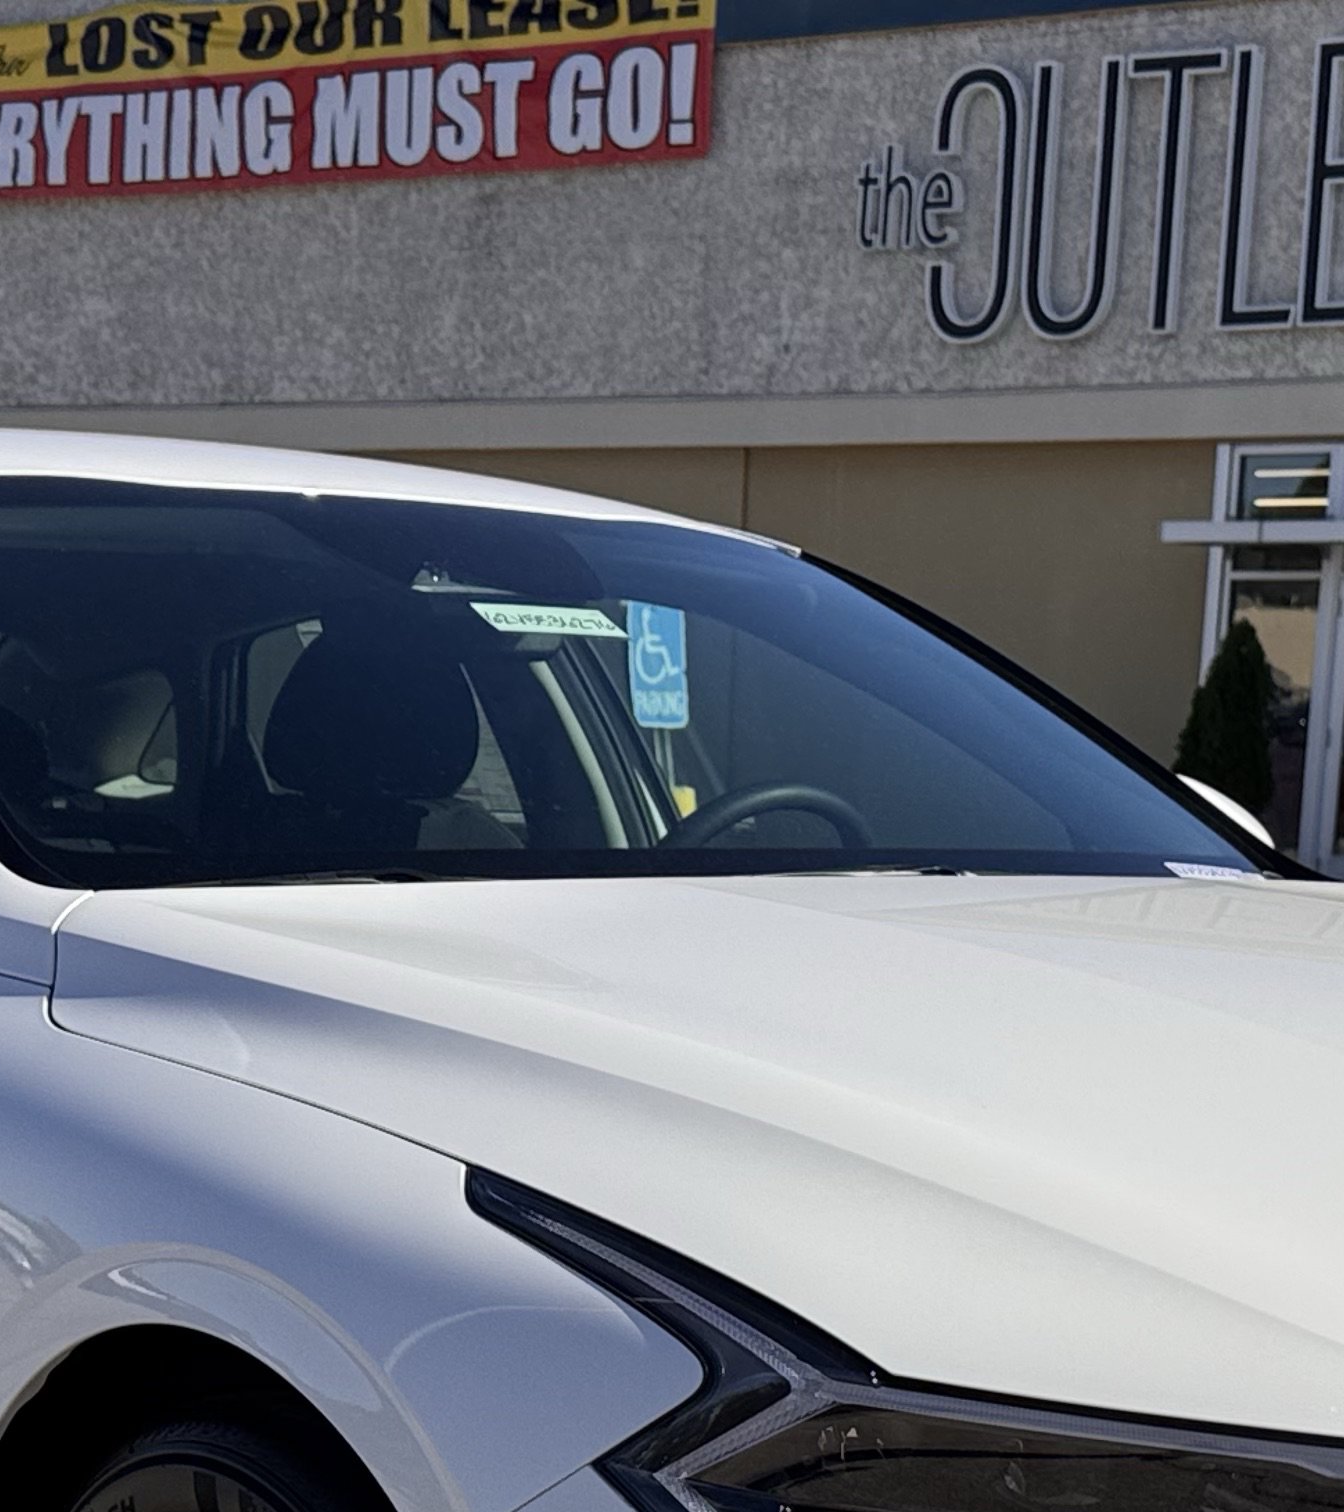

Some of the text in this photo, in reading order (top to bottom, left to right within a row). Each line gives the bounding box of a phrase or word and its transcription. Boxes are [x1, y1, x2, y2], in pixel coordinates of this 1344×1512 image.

[45, 10, 222, 78] LOST
[238, 0, 405, 60] OUR
[310, 59, 537, 170] MUST
[548, 41, 699, 155] GO!
[857, 145, 956, 250] the
